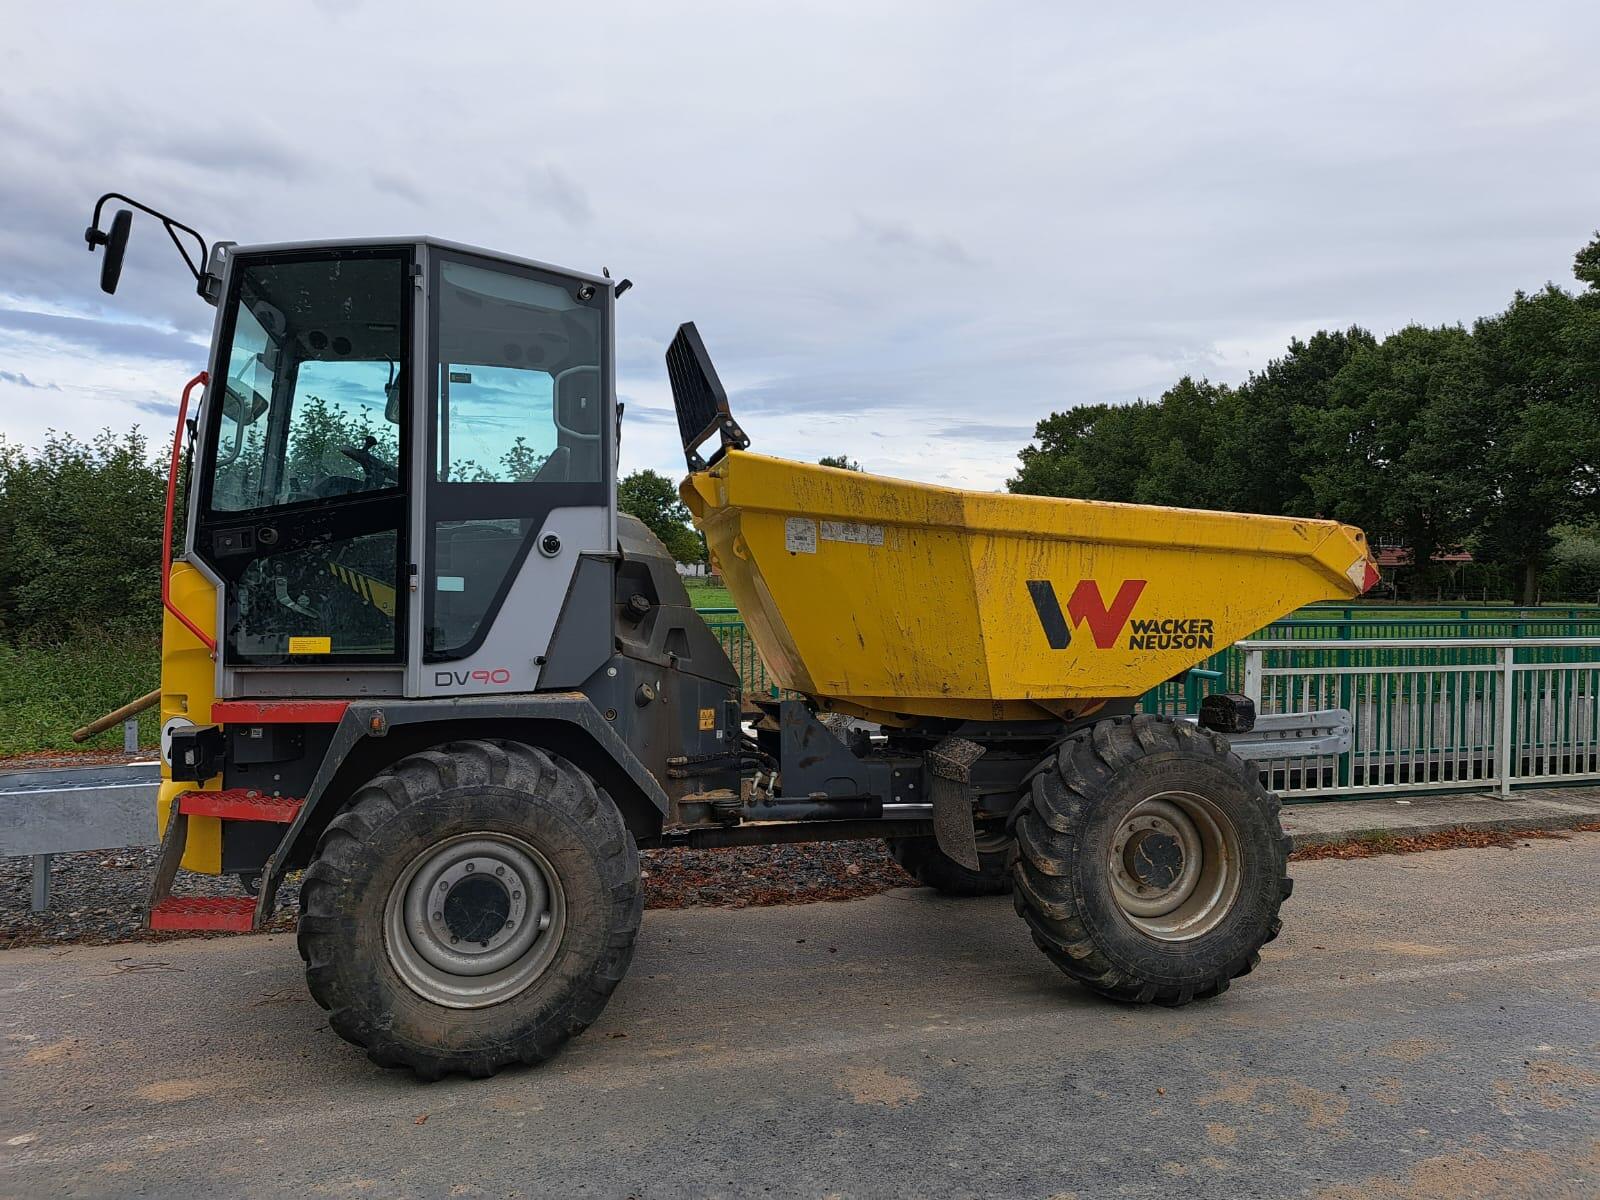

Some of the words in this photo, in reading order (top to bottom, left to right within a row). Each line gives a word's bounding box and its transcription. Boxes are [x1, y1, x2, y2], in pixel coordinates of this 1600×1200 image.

[1130, 619, 1214, 634] WACKER
[1129, 634, 1213, 650] NEUSON
[435, 669, 511, 687] DV90
